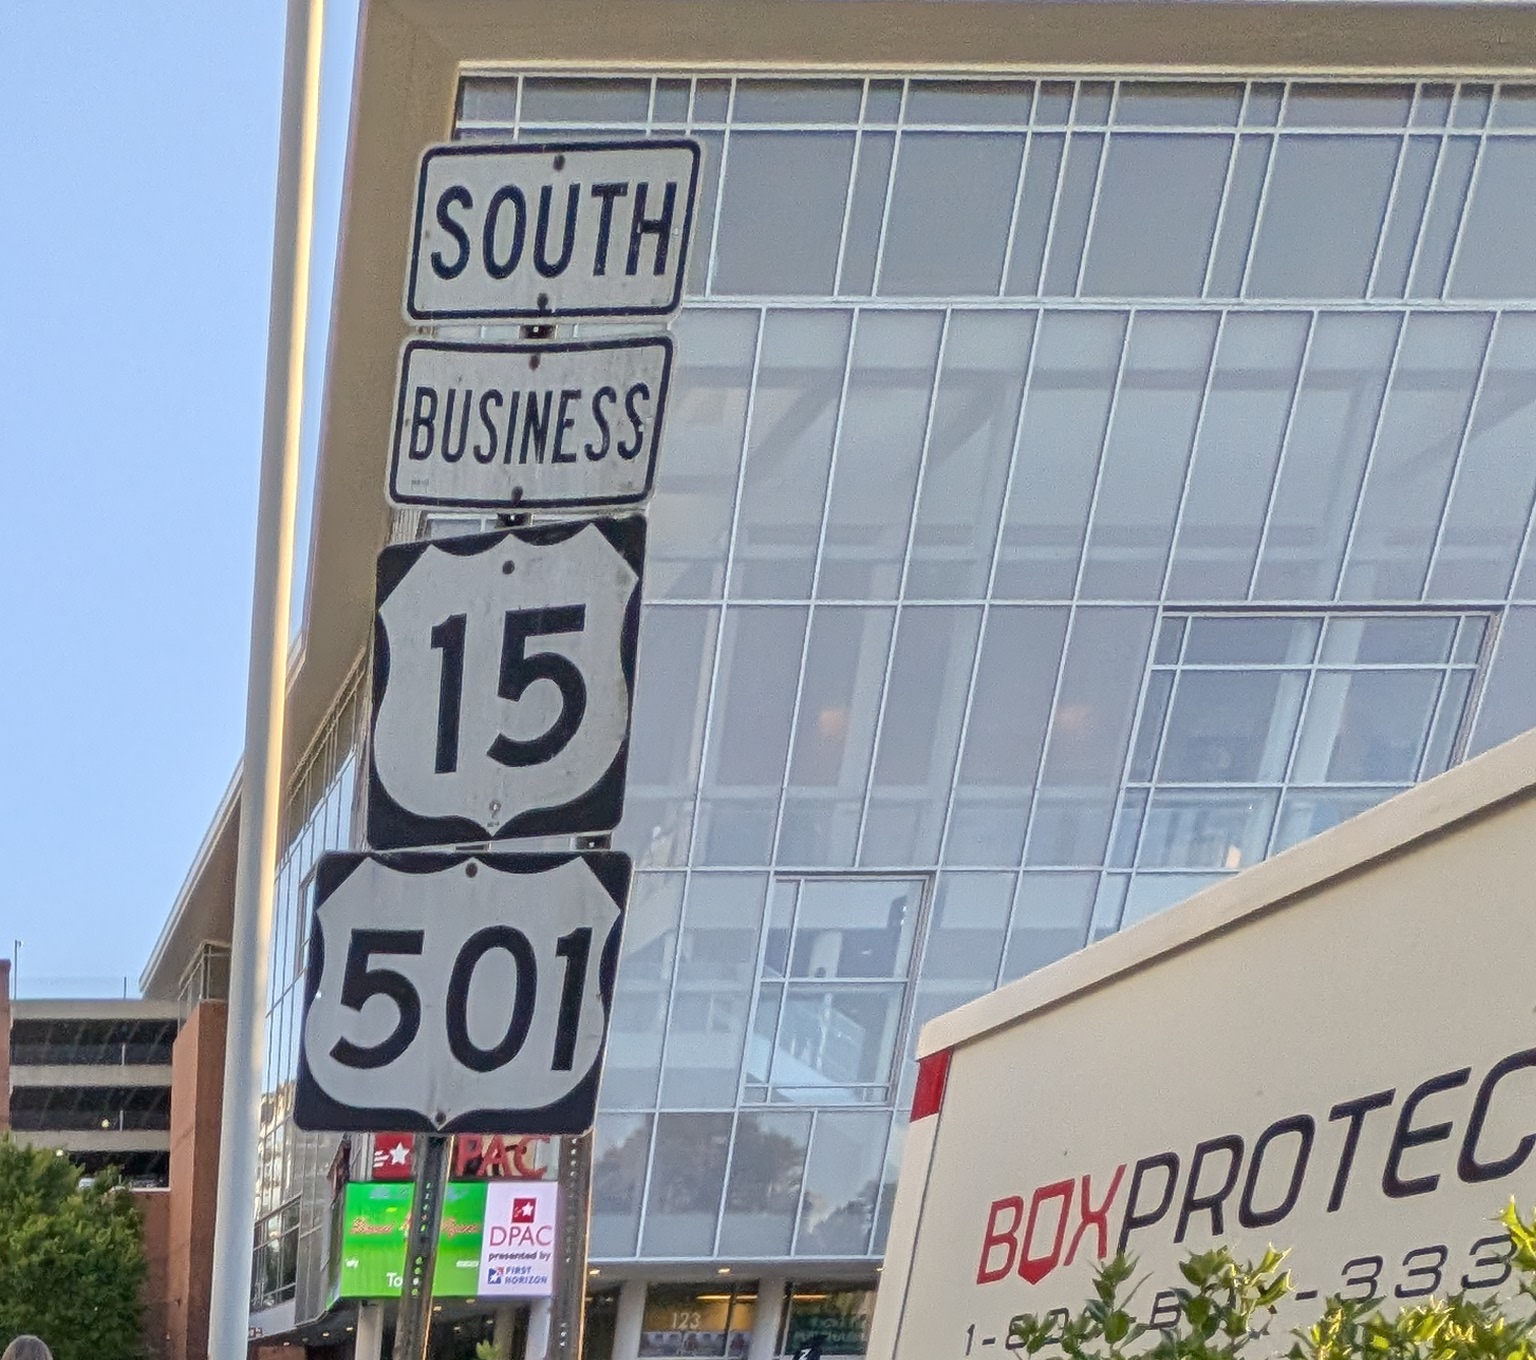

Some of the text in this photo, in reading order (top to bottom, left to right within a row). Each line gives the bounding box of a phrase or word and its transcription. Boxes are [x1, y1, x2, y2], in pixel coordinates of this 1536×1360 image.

[430, 181, 679, 281] SOUTH
[407, 382, 651, 465] BUSINESS
[430, 603, 589, 775] 15
[329, 925, 594, 1073] 501
[453, 1132, 552, 1179] PAC
[489, 1225, 554, 1247] DPAC
[488, 1251, 553, 1263] presented by
[505, 1265, 532, 1275] FIRST
[504, 1275, 548, 1285] HORIZON
[671, 1311, 701, 1330] 123
